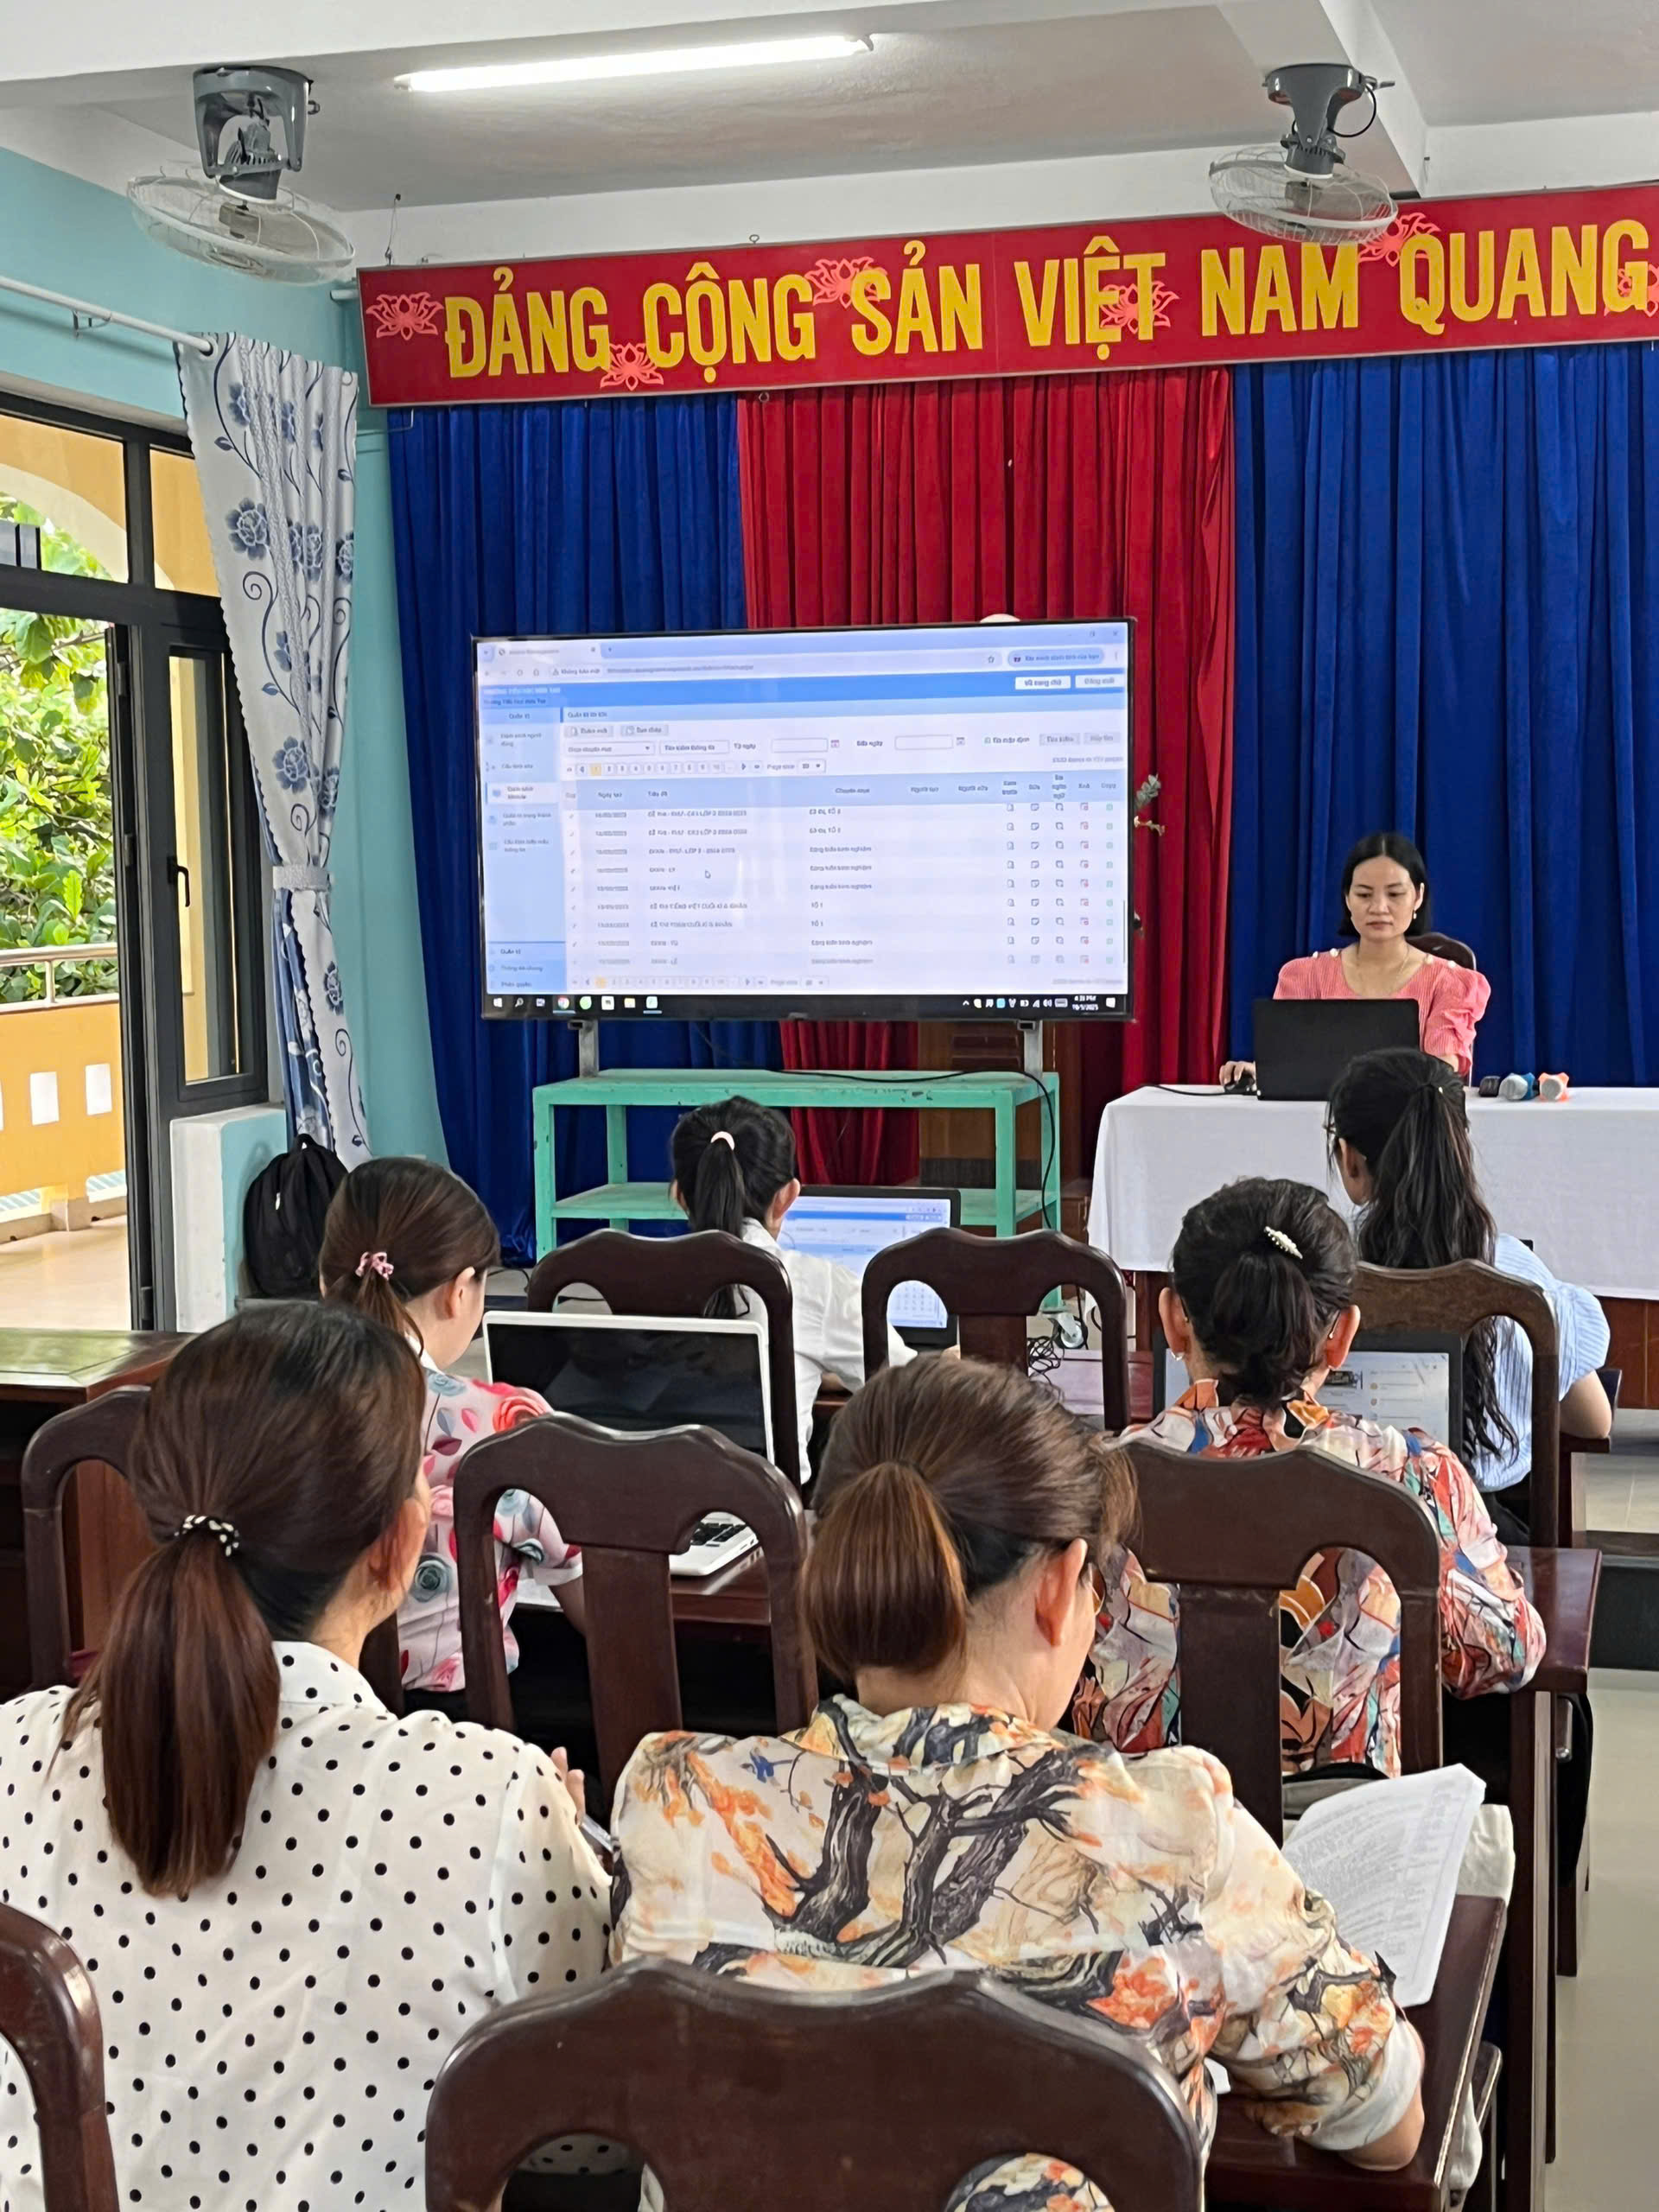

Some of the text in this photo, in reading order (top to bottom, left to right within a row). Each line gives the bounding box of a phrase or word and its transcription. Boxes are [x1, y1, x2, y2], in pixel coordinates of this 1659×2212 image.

[444, 219, 1649, 384] ĐẢNG CỘNG SẢN VIỆT NAM QUANG
